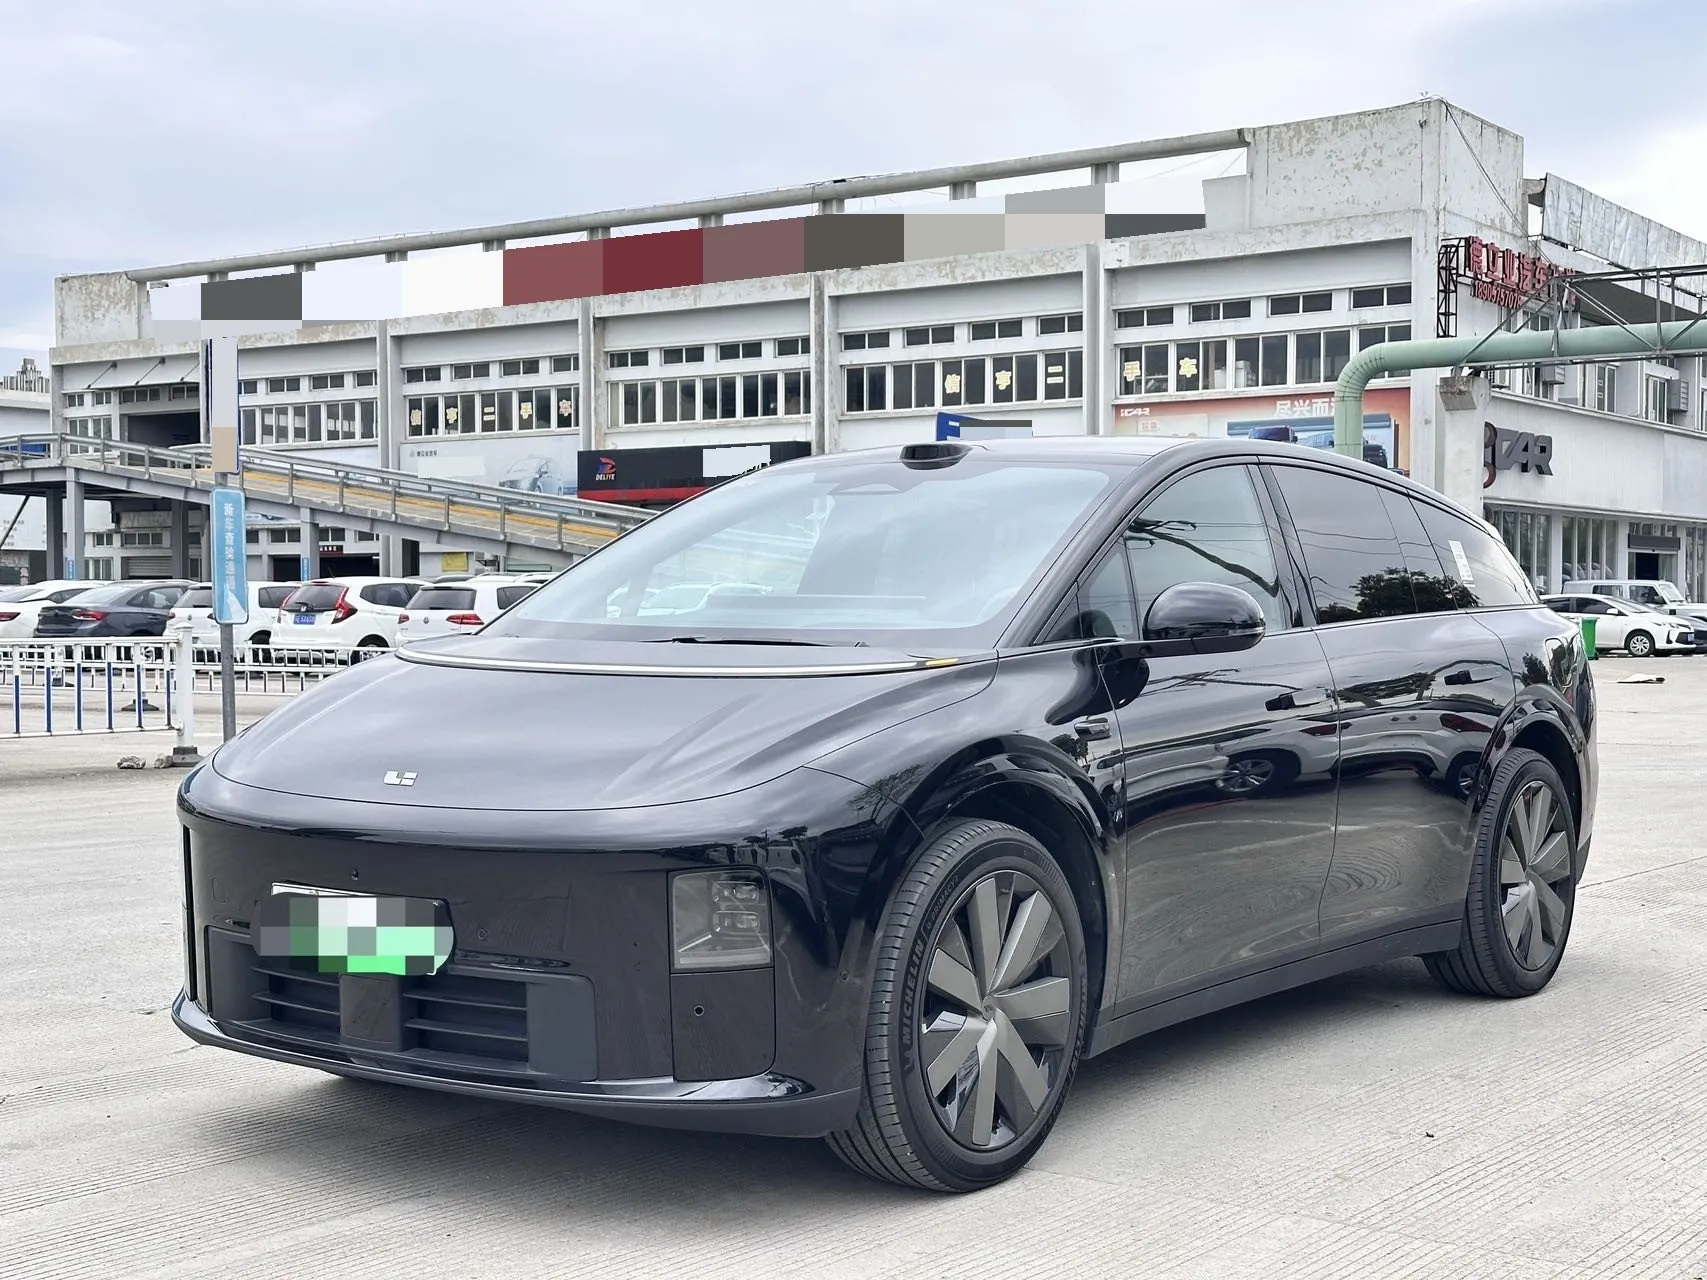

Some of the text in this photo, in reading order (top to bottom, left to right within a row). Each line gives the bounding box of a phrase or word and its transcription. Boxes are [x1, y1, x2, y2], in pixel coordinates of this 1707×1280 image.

[1274, 398, 1334, 417] 尽兴而
[902, 937, 926, 1047] MICHELIN
